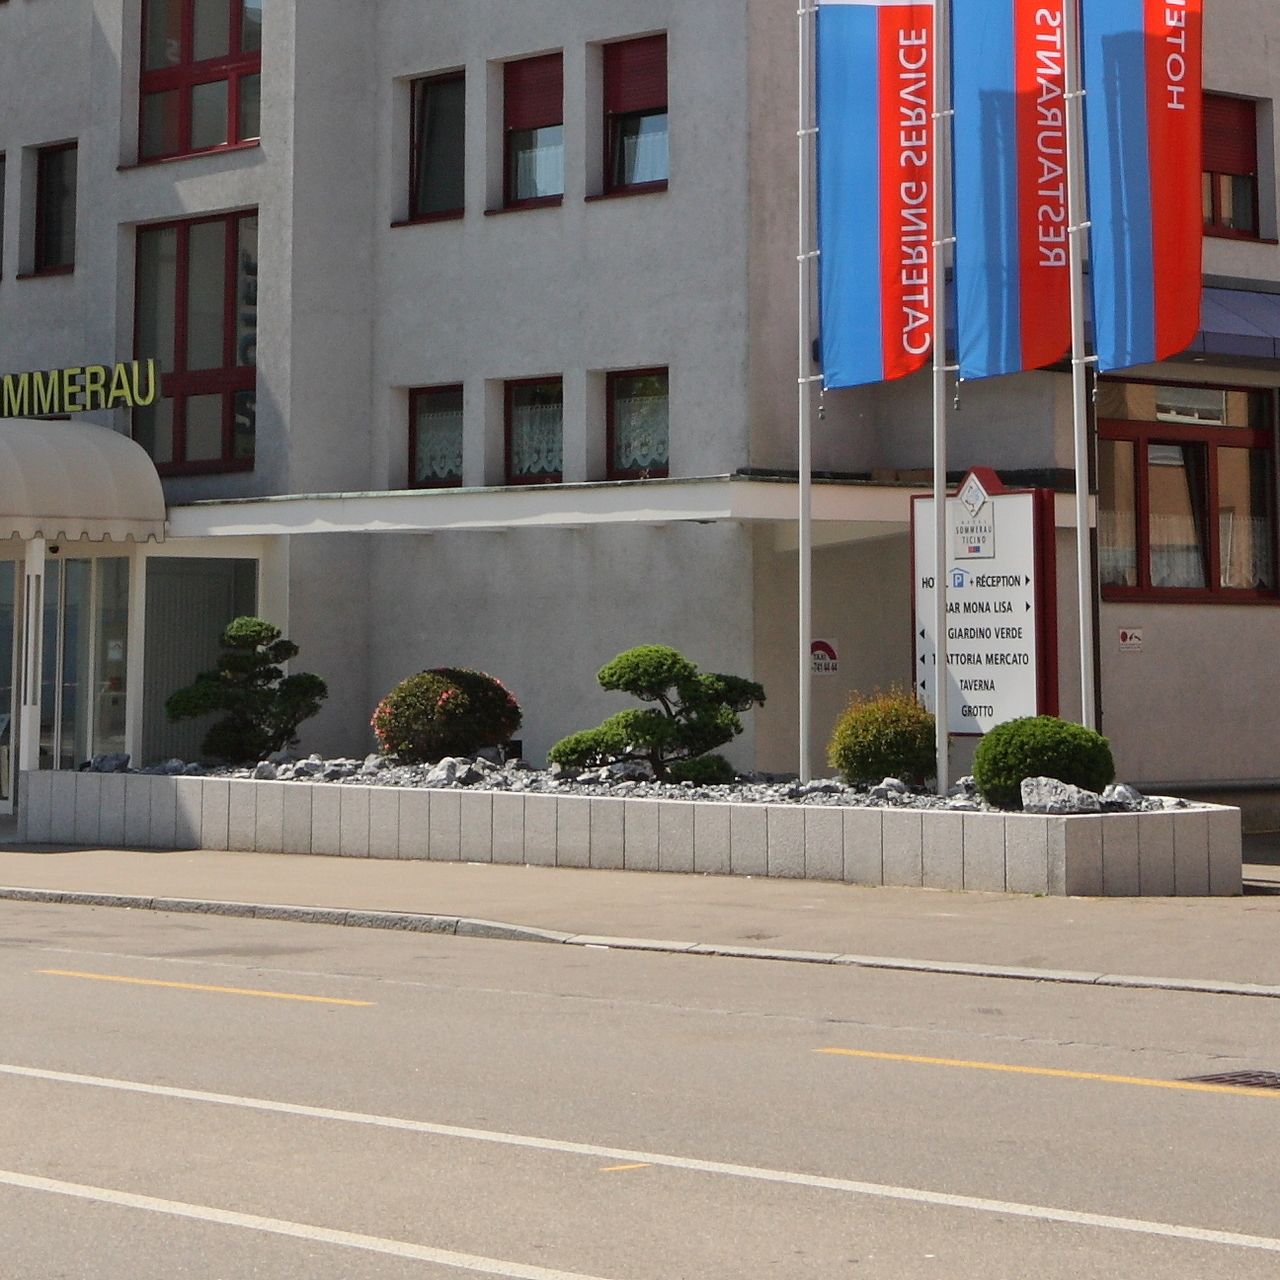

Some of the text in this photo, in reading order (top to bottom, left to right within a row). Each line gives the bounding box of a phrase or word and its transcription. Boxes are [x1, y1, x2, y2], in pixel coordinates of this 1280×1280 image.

[963, 601, 990, 613] MONA
[994, 601, 1013, 613] LISA
[948, 627, 1023, 639] GIARDINO VERDE
[932, 653, 1029, 665] TATTORIA MERCATO
[960, 679, 996, 691] TAVERNA
[961, 705, 994, 718] GROTTO
